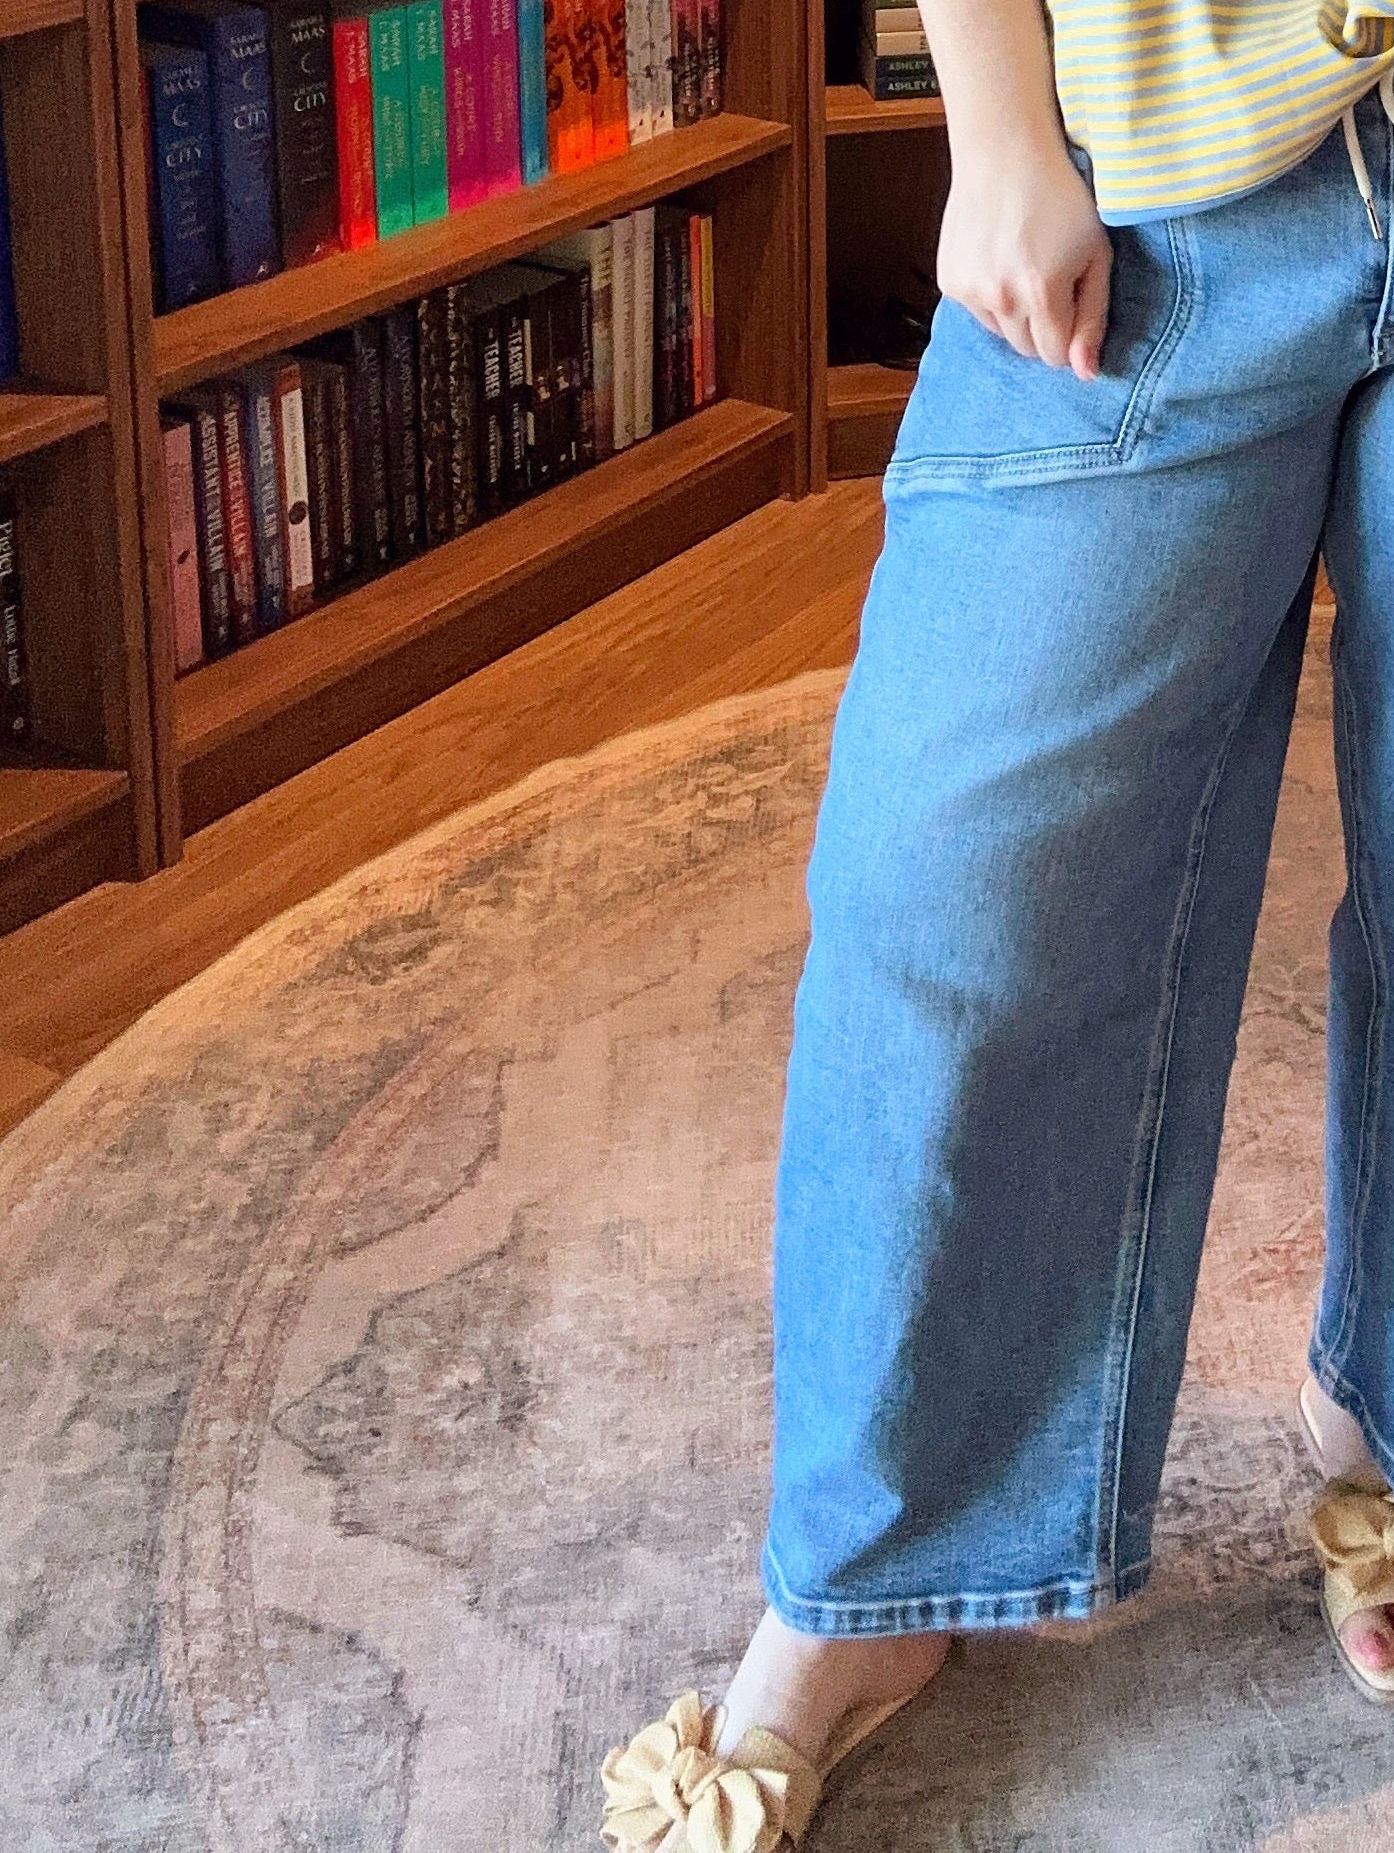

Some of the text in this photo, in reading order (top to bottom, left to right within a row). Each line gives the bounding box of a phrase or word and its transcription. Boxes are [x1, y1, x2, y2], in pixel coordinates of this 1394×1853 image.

[293, 93, 327, 113] CITY
[233, 109, 268, 130] CITY
[166, 146, 202, 168] CITY
[508, 330, 524, 388] TEACHER
[484, 341, 500, 400] TEACHER
